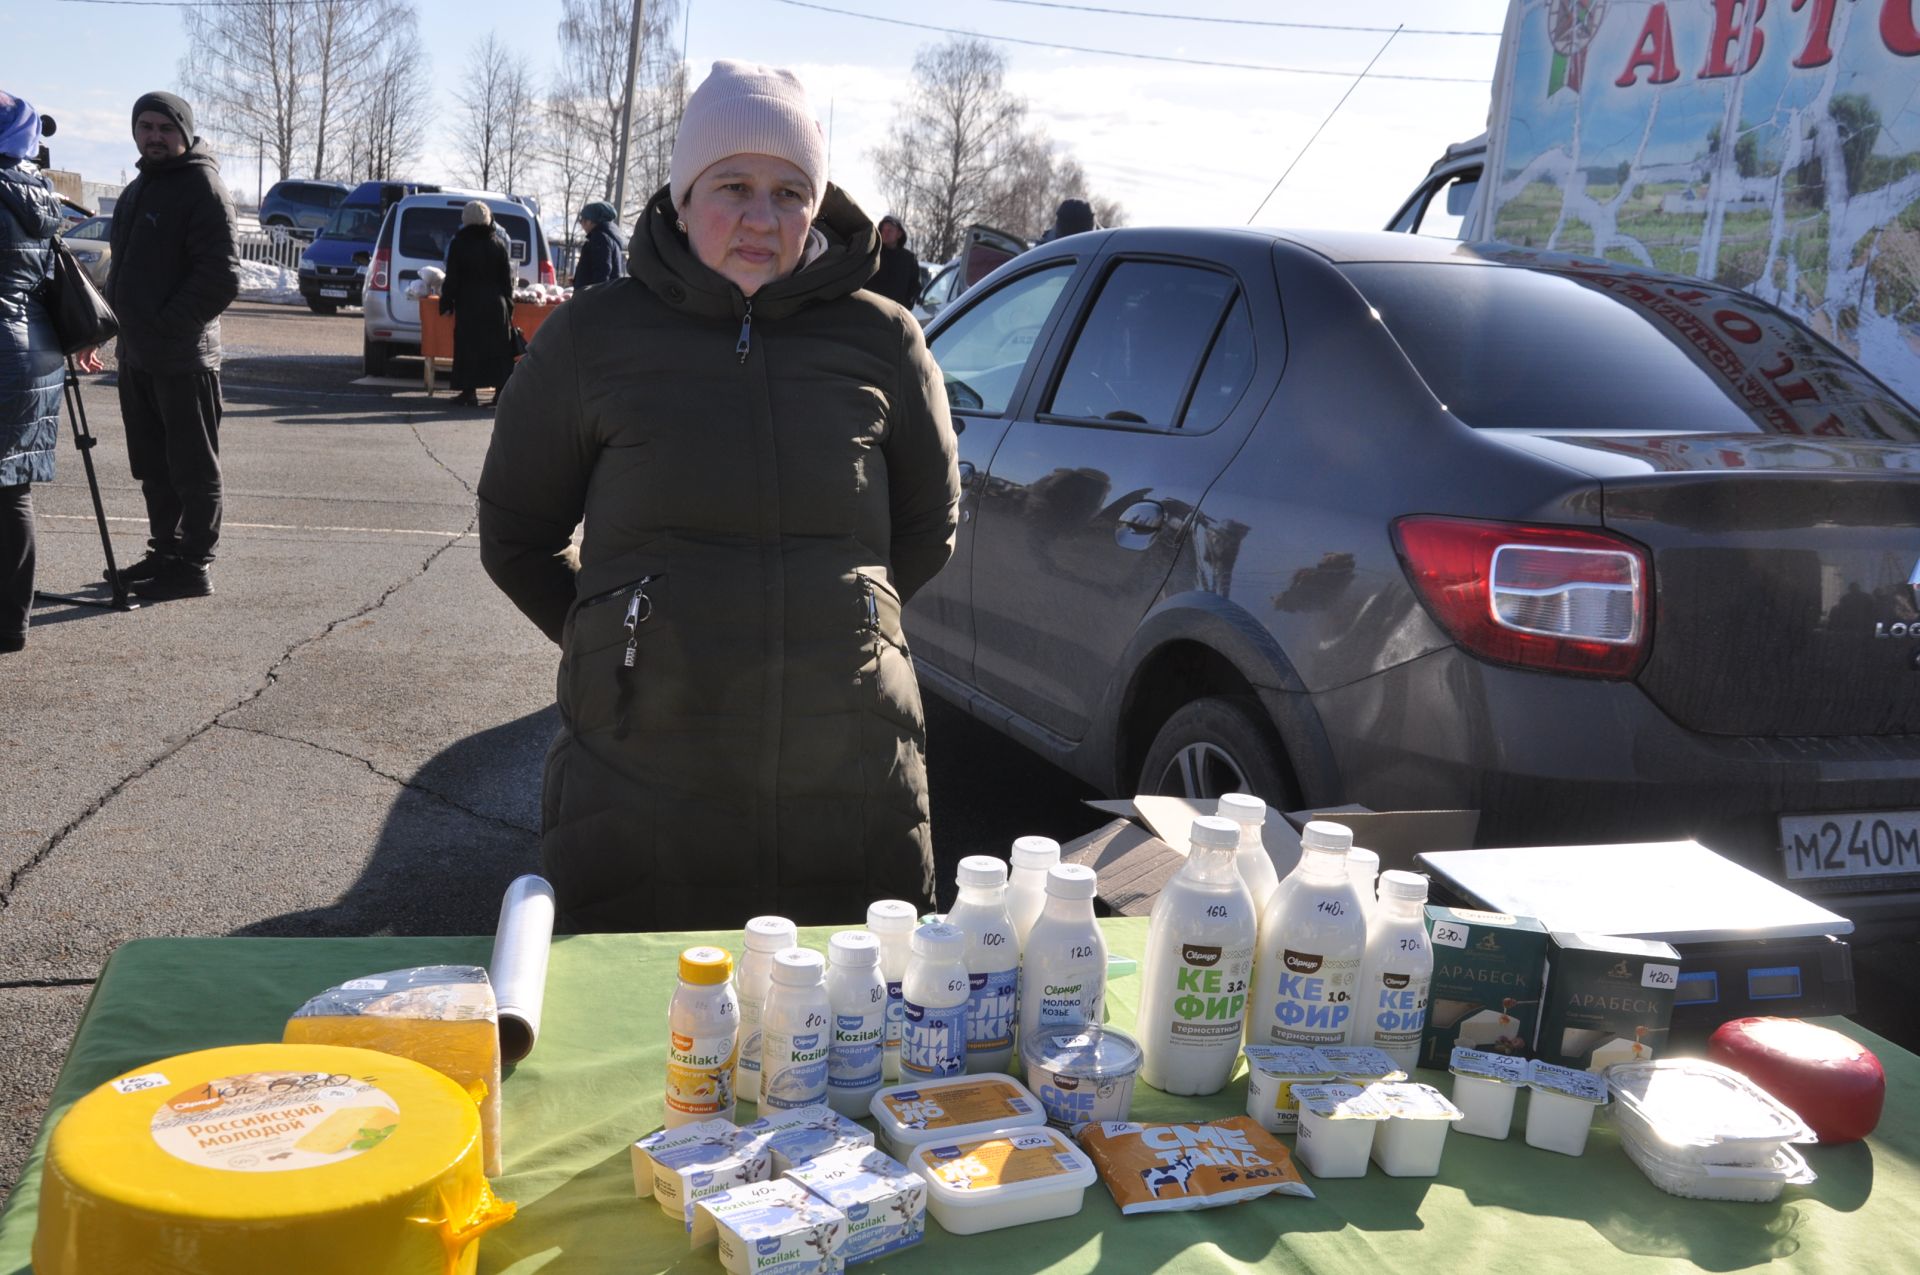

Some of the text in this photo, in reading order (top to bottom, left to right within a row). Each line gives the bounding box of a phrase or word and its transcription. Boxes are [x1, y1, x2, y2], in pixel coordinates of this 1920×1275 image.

[1177, 967, 1223, 994] КЕ
[1278, 972, 1324, 1002] КЕ
[1438, 964, 1529, 987] АРАБЕСК
[1174, 993, 1245, 1021] ФИР
[1274, 1000, 1350, 1029] ФИР
[1568, 993, 1658, 1013] АРАБЕСК
[1141, 1125, 1257, 1151] СМЕ
[847, 1214, 887, 1234] Kozilakt
[757, 1247, 801, 1268] Kozilakt
